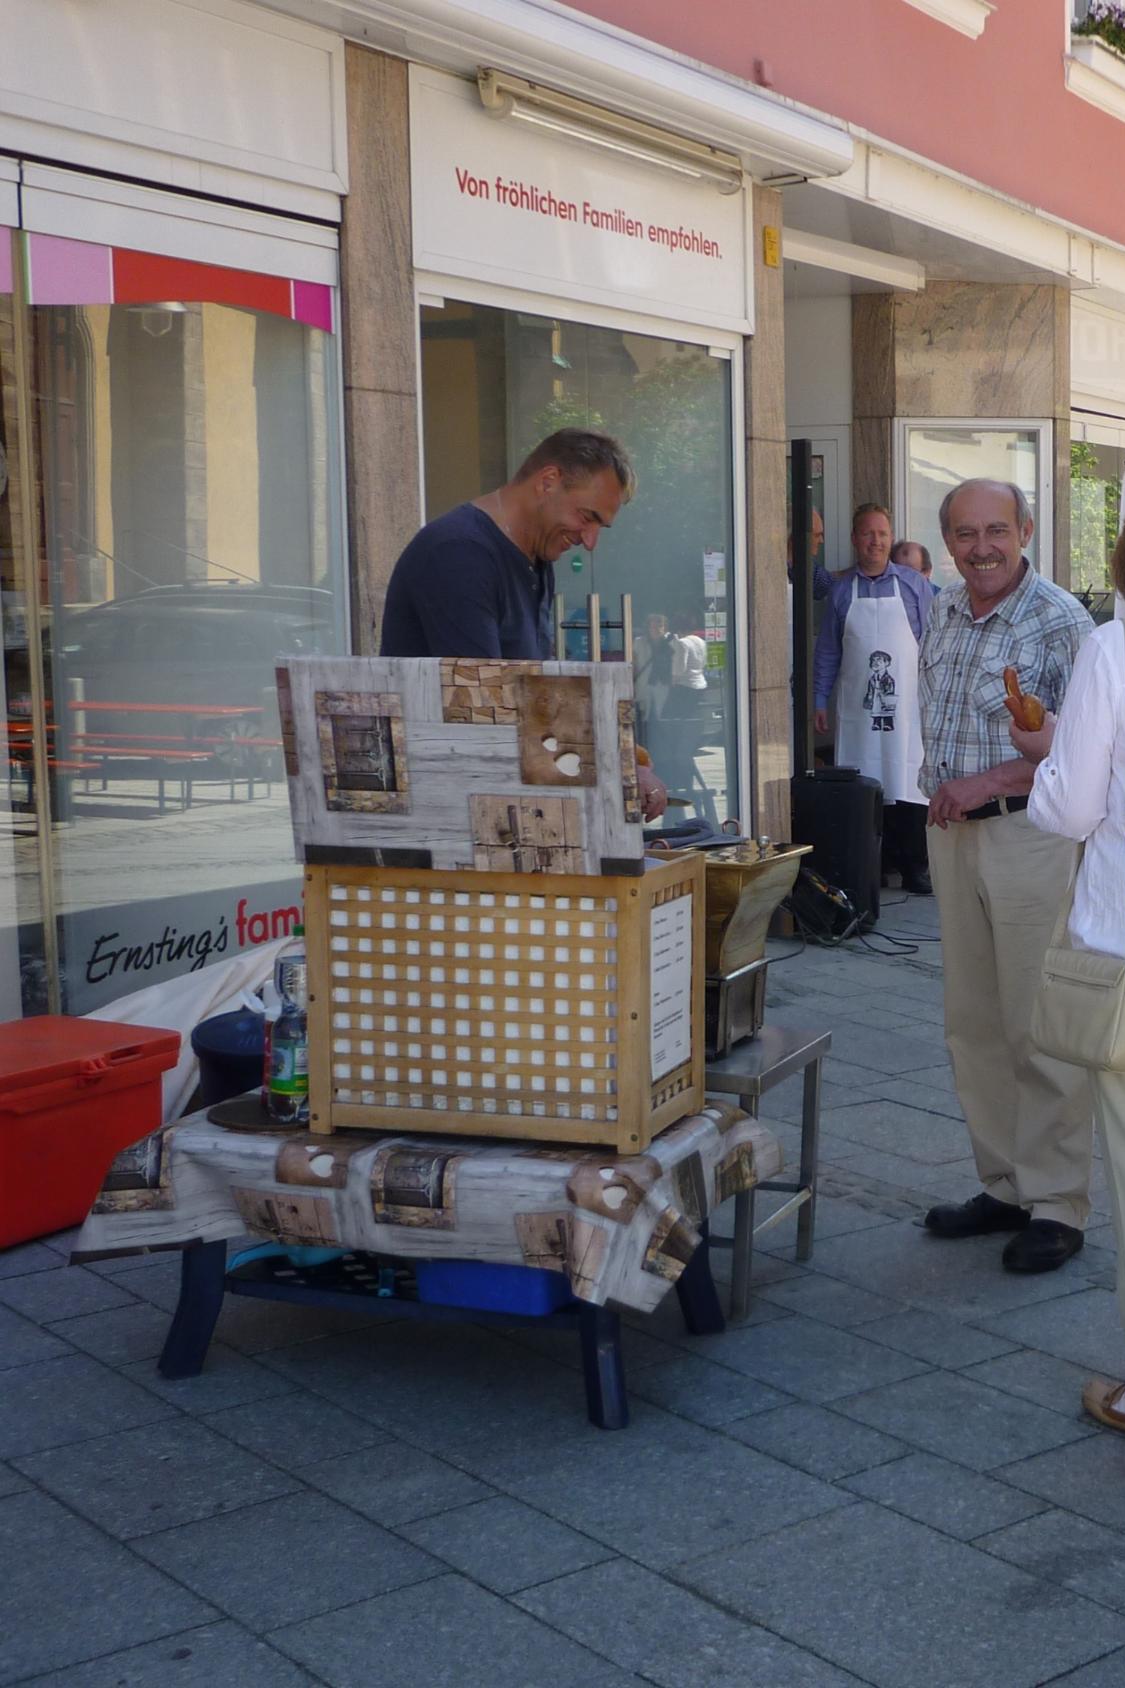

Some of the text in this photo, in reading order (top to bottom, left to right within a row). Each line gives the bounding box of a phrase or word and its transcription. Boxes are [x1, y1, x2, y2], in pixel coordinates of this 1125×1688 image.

[455, 167, 723, 259] Von fröhlichen Familien empfohlen.
[86, 916, 228, 984] Ernsting's
